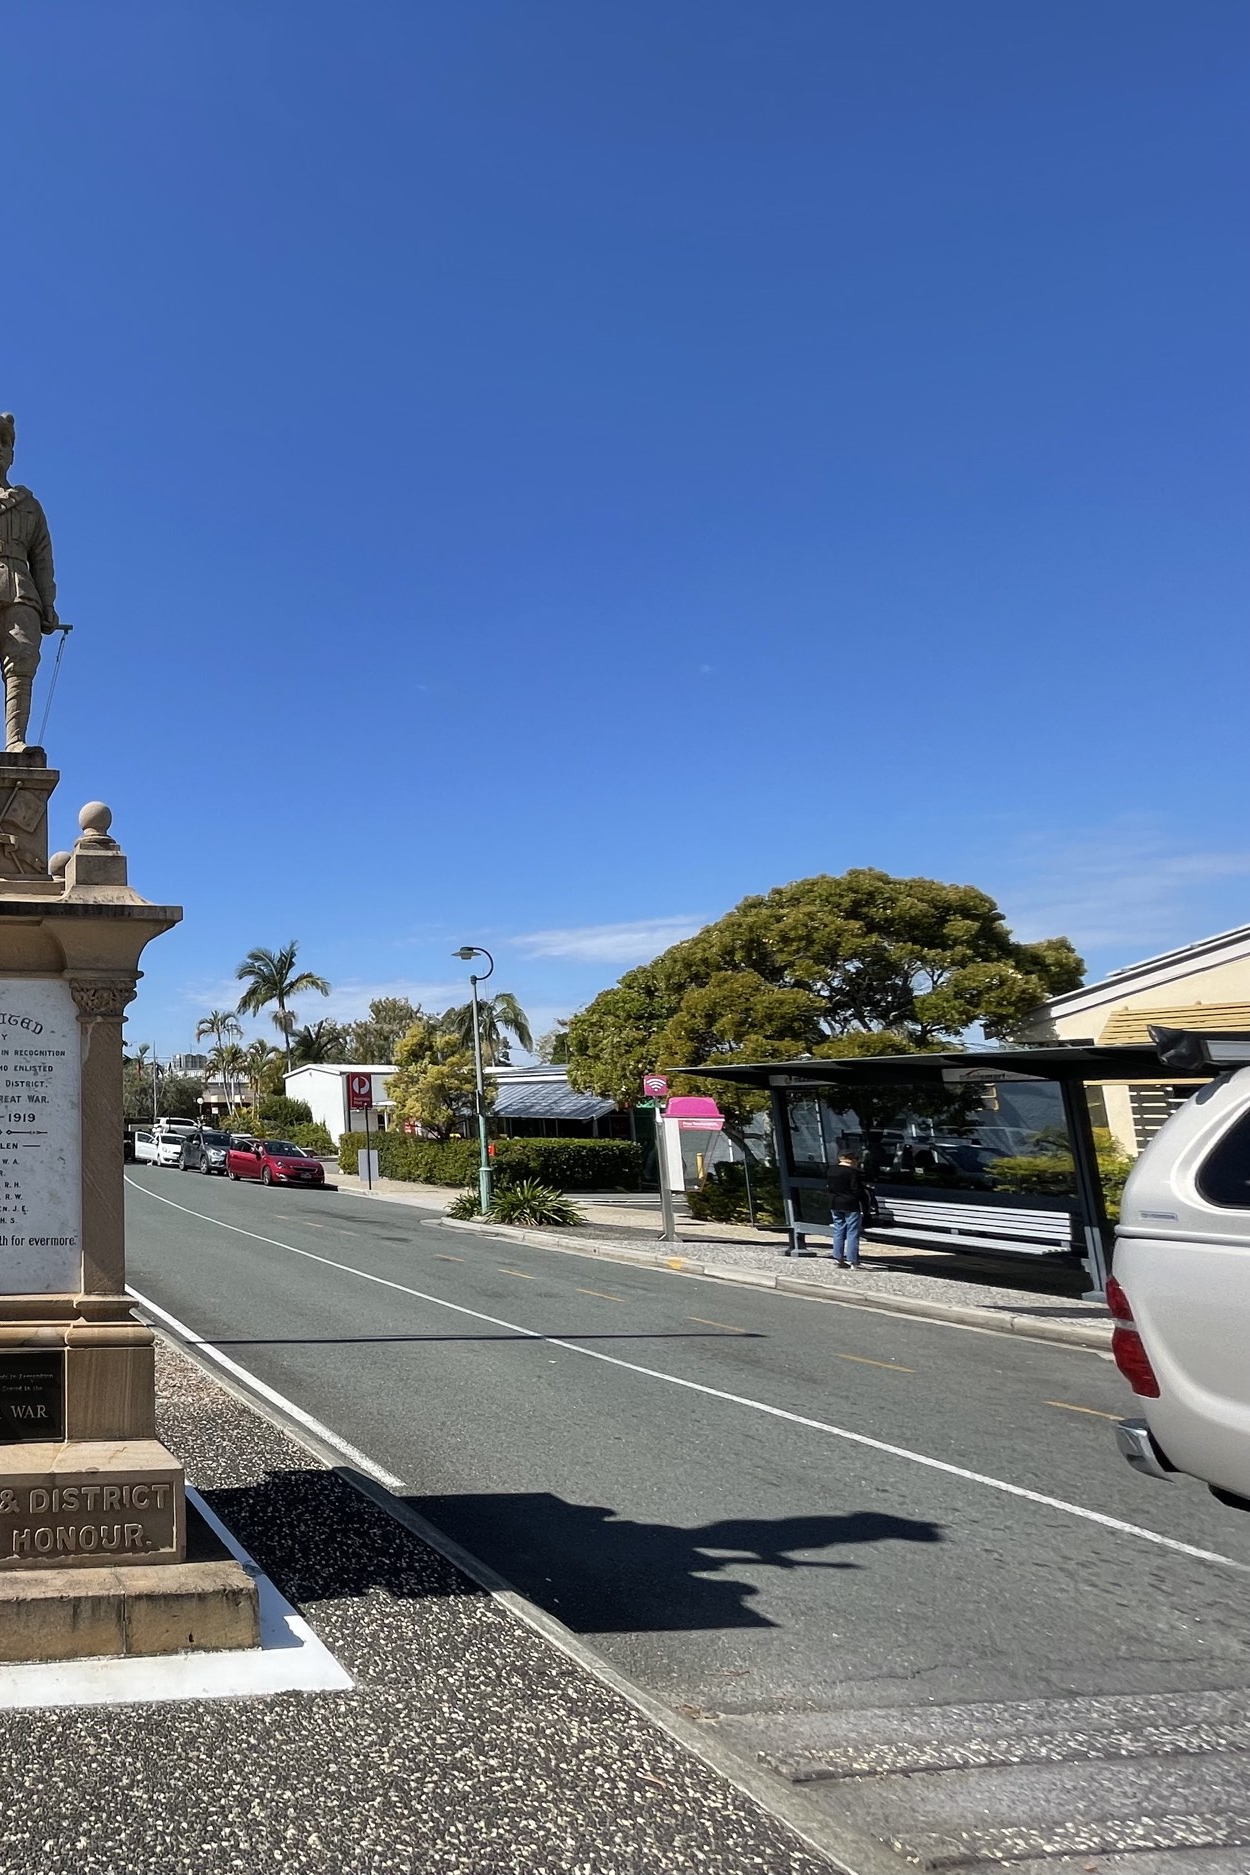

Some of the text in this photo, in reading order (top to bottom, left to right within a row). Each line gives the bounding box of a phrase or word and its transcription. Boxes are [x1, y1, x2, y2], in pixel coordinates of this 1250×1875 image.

[14, 1049, 66, 1057] RECOGNITION
[14, 1064, 54, 1072] ENLISTED
[8, 1112, 36, 1122] 1919
[11, 1235, 25, 1247] for
[10, 1404, 49, 1419] WAR
[29, 1484, 170, 1515] DISTRICT
